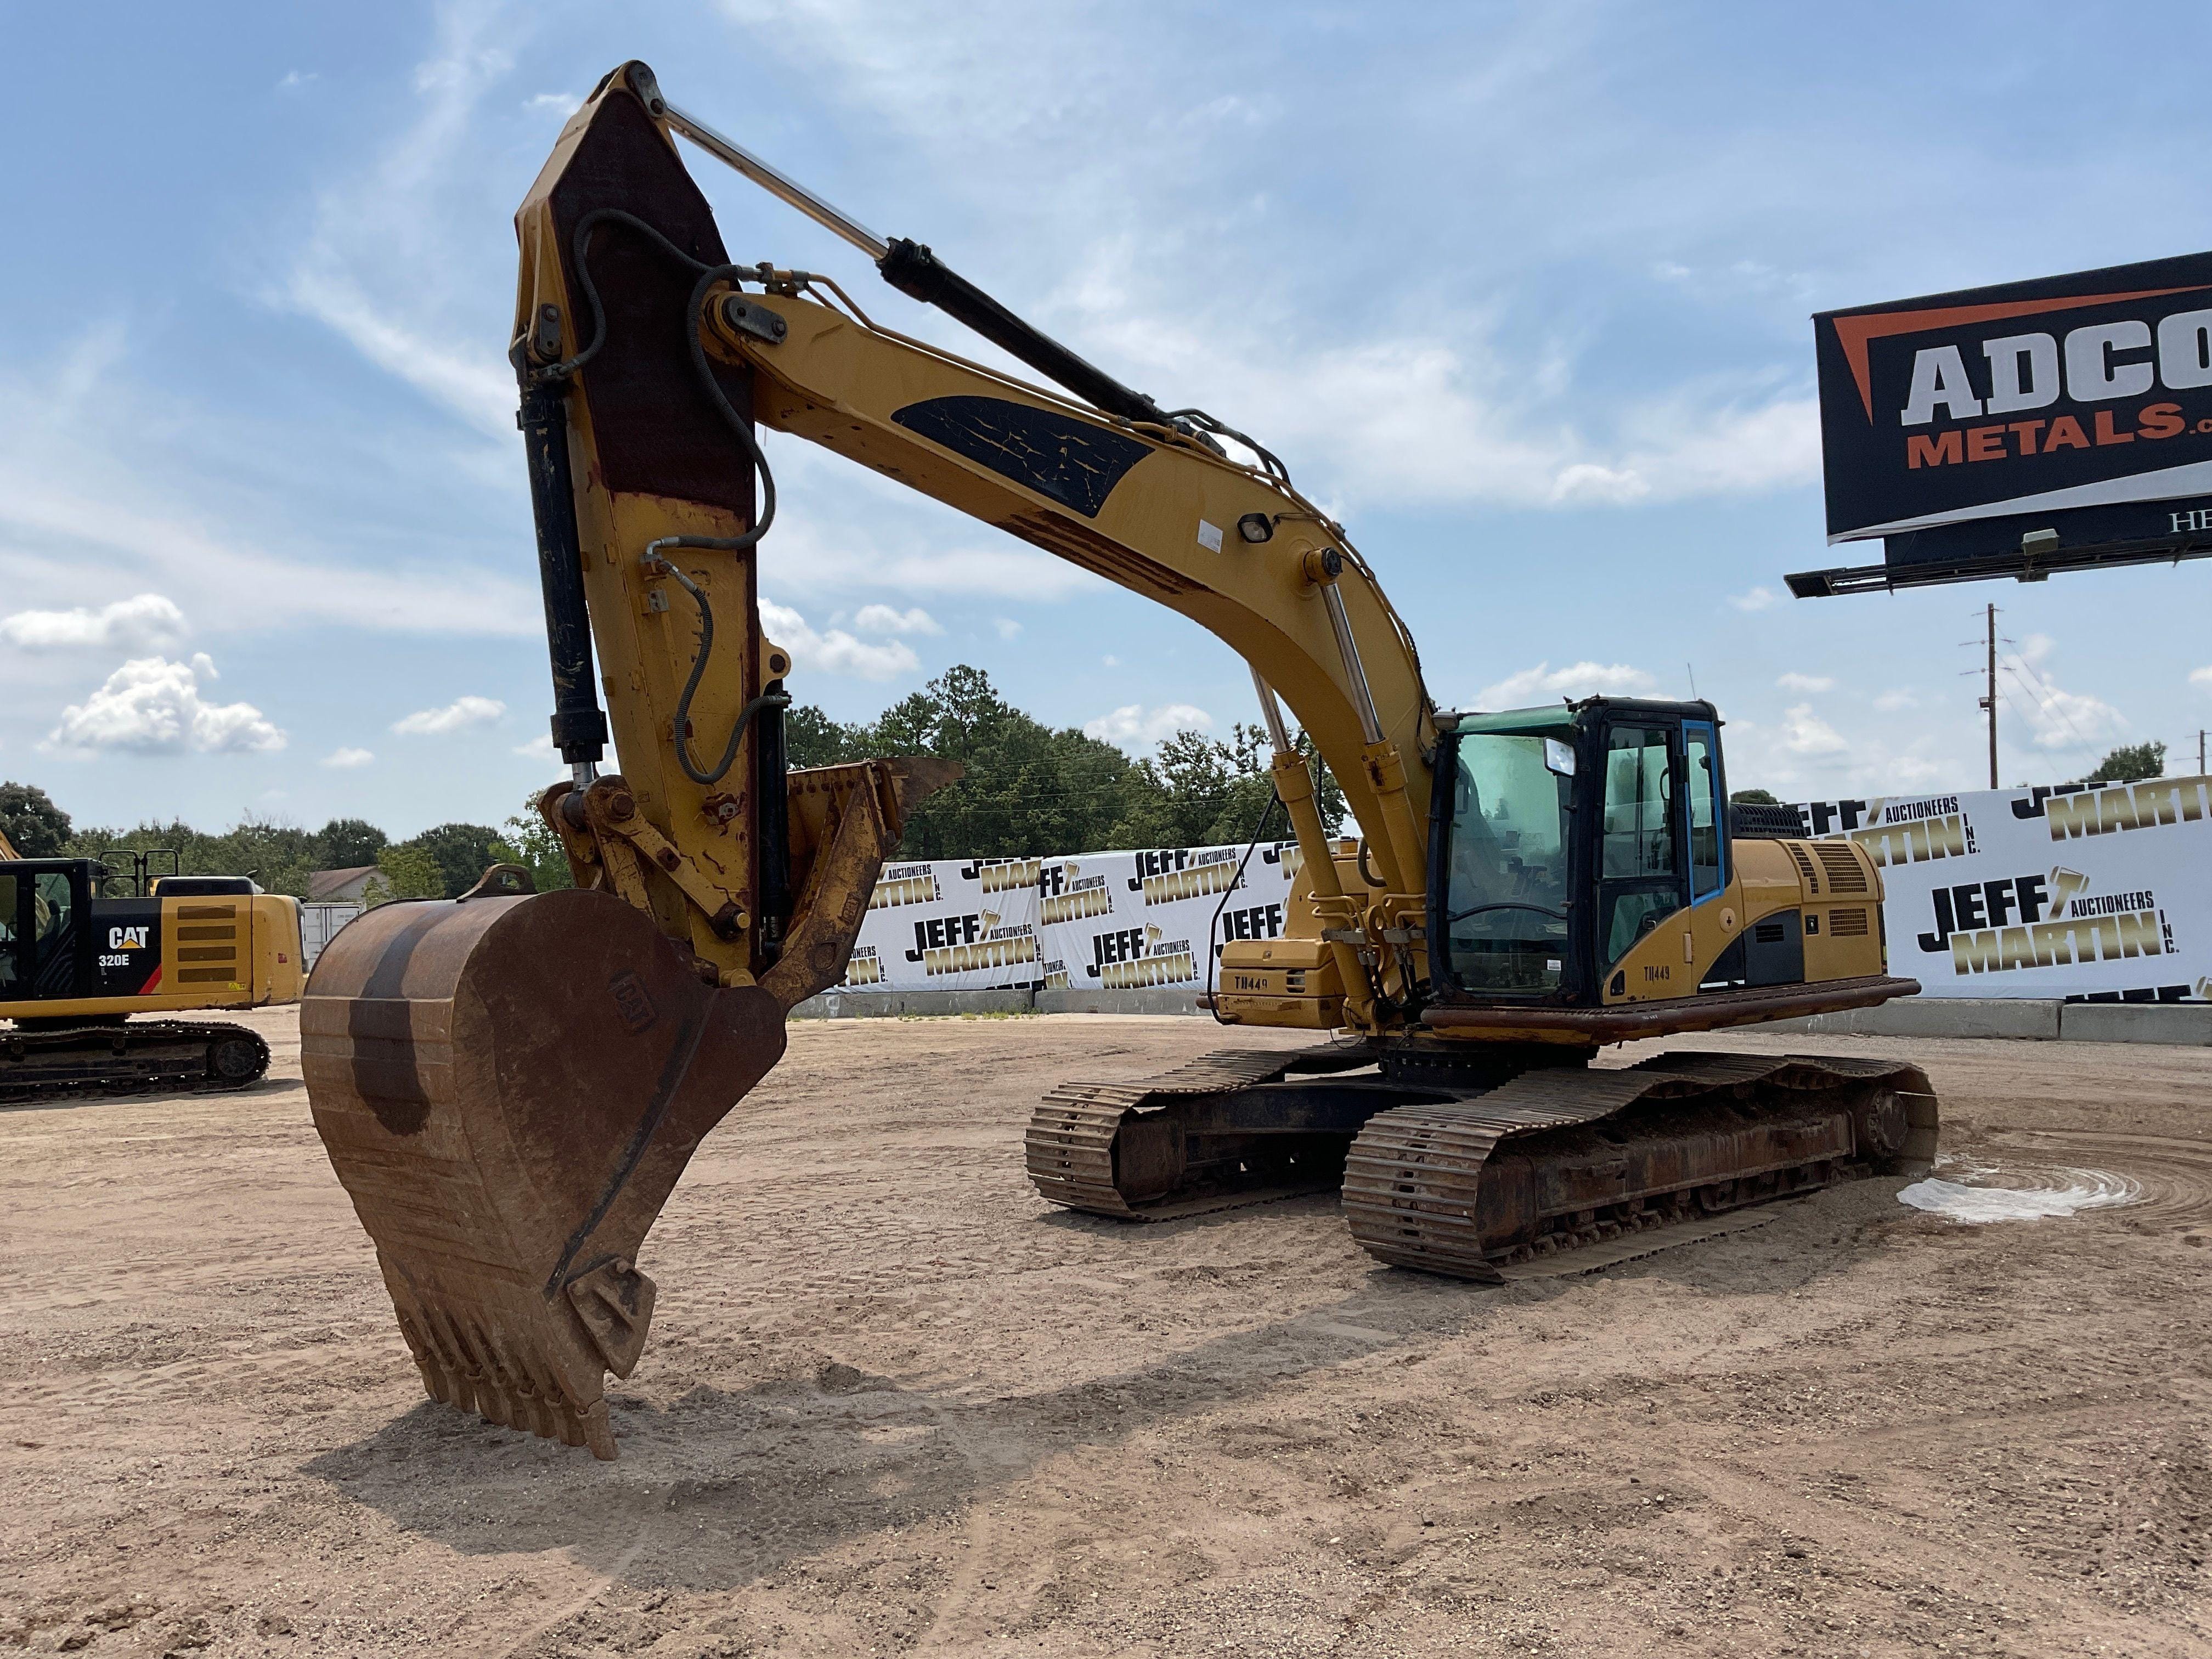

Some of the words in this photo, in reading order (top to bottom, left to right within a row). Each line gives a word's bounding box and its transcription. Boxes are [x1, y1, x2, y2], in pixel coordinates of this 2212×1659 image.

[1901, 308, 2212, 426] ADCO
[1886, 797, 1959, 823] AUCTIONEERS
[2047, 775, 2212, 842] MART
[888, 864, 932, 881] AUCTIONEERS
[1127, 850, 1188, 891] JEFF
[1198, 848, 1236, 866] AUCTIONEERS
[1072, 875, 1105, 892] AUCTIONEERS
[1143, 860, 1240, 906] MARTIN
[1040, 888, 1108, 926] ARTIN
[1917, 874, 2049, 952] JEFF
[2070, 890, 2154, 918] AUCTIONEERS
[109, 927, 149, 949] CAT
[905, 914, 980, 962] JEFF
[990, 923, 1032, 940] AUCTIONEERS
[1153, 939, 1189, 956] AUCTIONEERS
[1951, 911, 2162, 975] MARTIN
[99, 954, 129, 967] 320E
[924, 936, 1034, 976] MARTIN
[1086, 928, 1144, 978] JEFF
[1102, 953, 1192, 989] MARTIN
